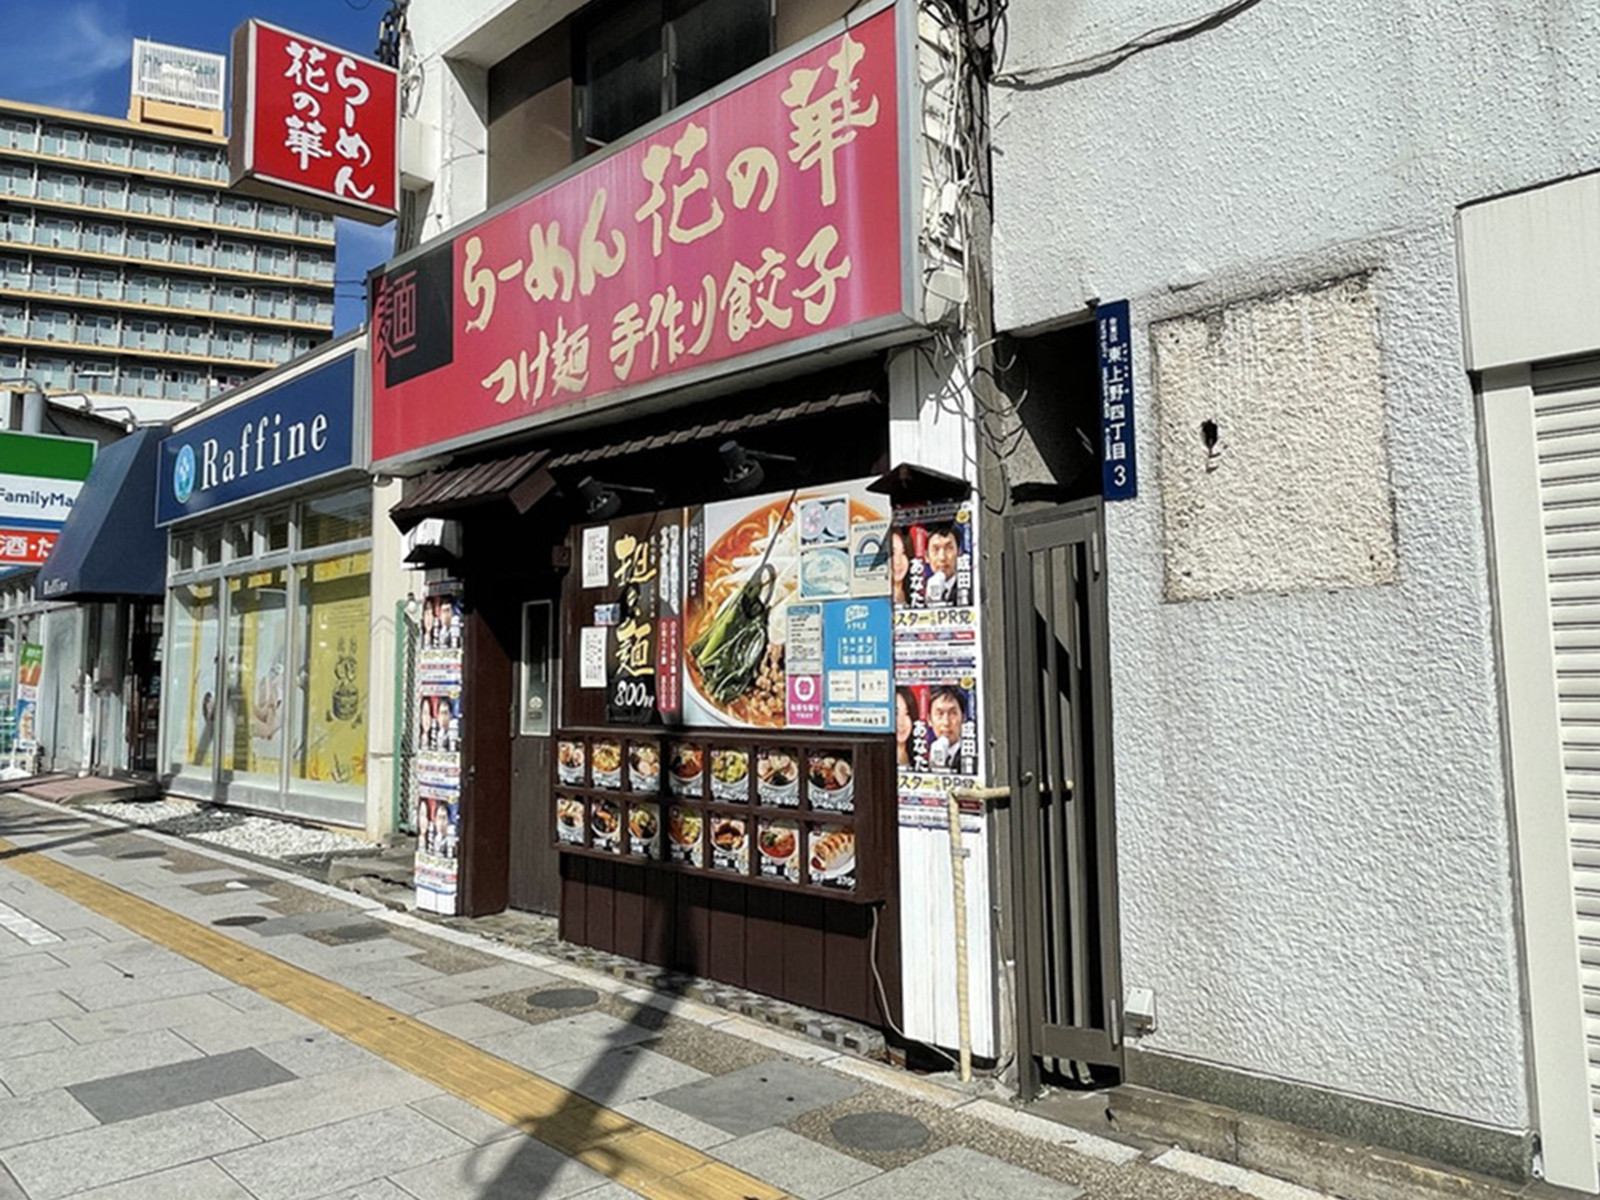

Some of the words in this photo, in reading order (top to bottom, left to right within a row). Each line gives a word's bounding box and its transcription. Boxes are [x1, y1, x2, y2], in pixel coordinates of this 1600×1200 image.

[284, 41, 333, 170] 花の華
[334, 56, 375, 200] らーめん
[462, 187, 627, 333] らーめん
[635, 33, 880, 257] 花の華
[481, 317, 590, 405] つけ麺
[608, 225, 852, 381] 手作り餃子
[201, 413, 328, 490] Raffine
[1113, 464, 1127, 487] 3
